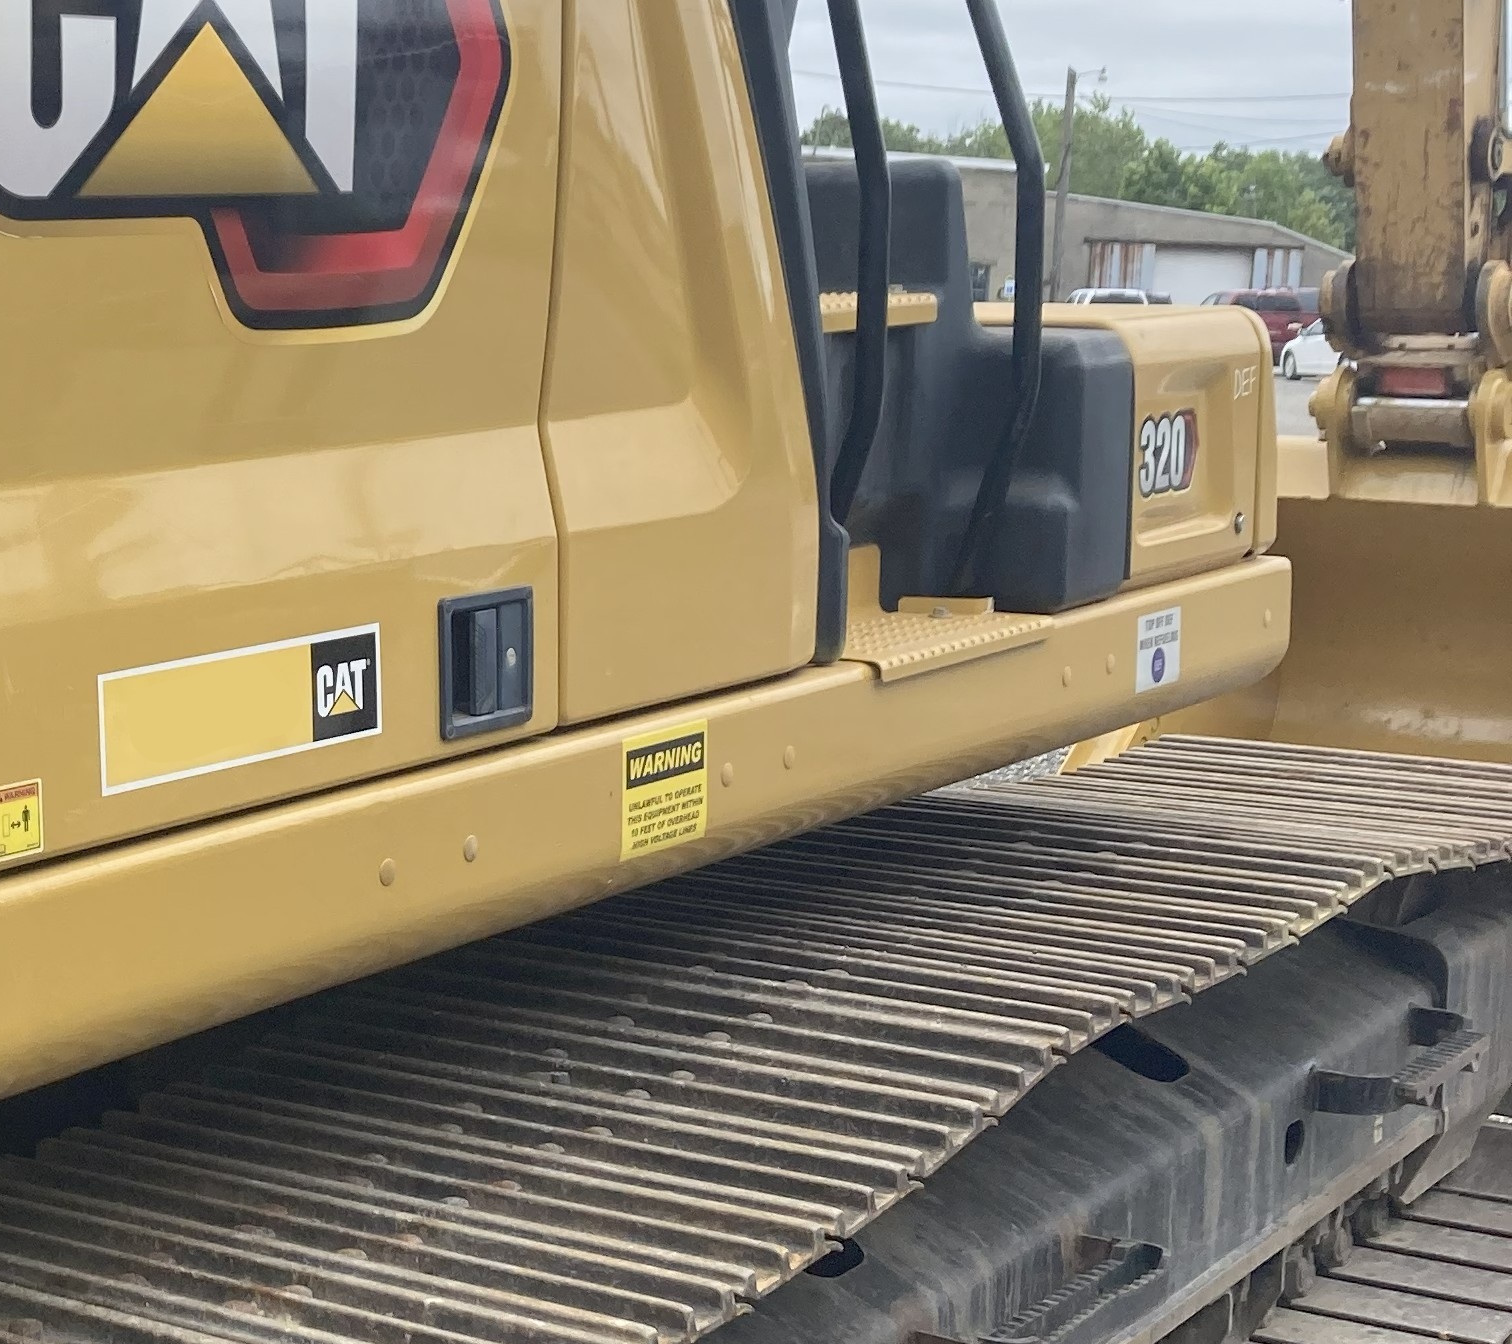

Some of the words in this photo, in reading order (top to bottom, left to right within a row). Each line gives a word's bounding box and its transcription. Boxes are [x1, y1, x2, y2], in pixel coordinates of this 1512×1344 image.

[1233, 366, 1256, 400] DEF
[1139, 414, 1186, 494] 320
[316, 658, 366, 718] CAT
[629, 741, 702, 780] WARNING
[5, 787, 35, 800] WARNING
[629, 795, 663, 812] UNLAWFUL
[665, 793, 673, 801] TO
[674, 784, 702, 799] OPERATE
[628, 814, 642, 825] THIS
[643, 804, 680, 822] EQUIPMENT
[681, 796, 704, 811] WITHIN
[640, 823, 656, 835] FEET
[657, 820, 666, 830] OF
[666, 810, 700, 827] OVERHEAD
[632, 838, 649, 849] HIGH
[650, 829, 677, 844] VOLTAGE
[678, 823, 697, 836] LINES
